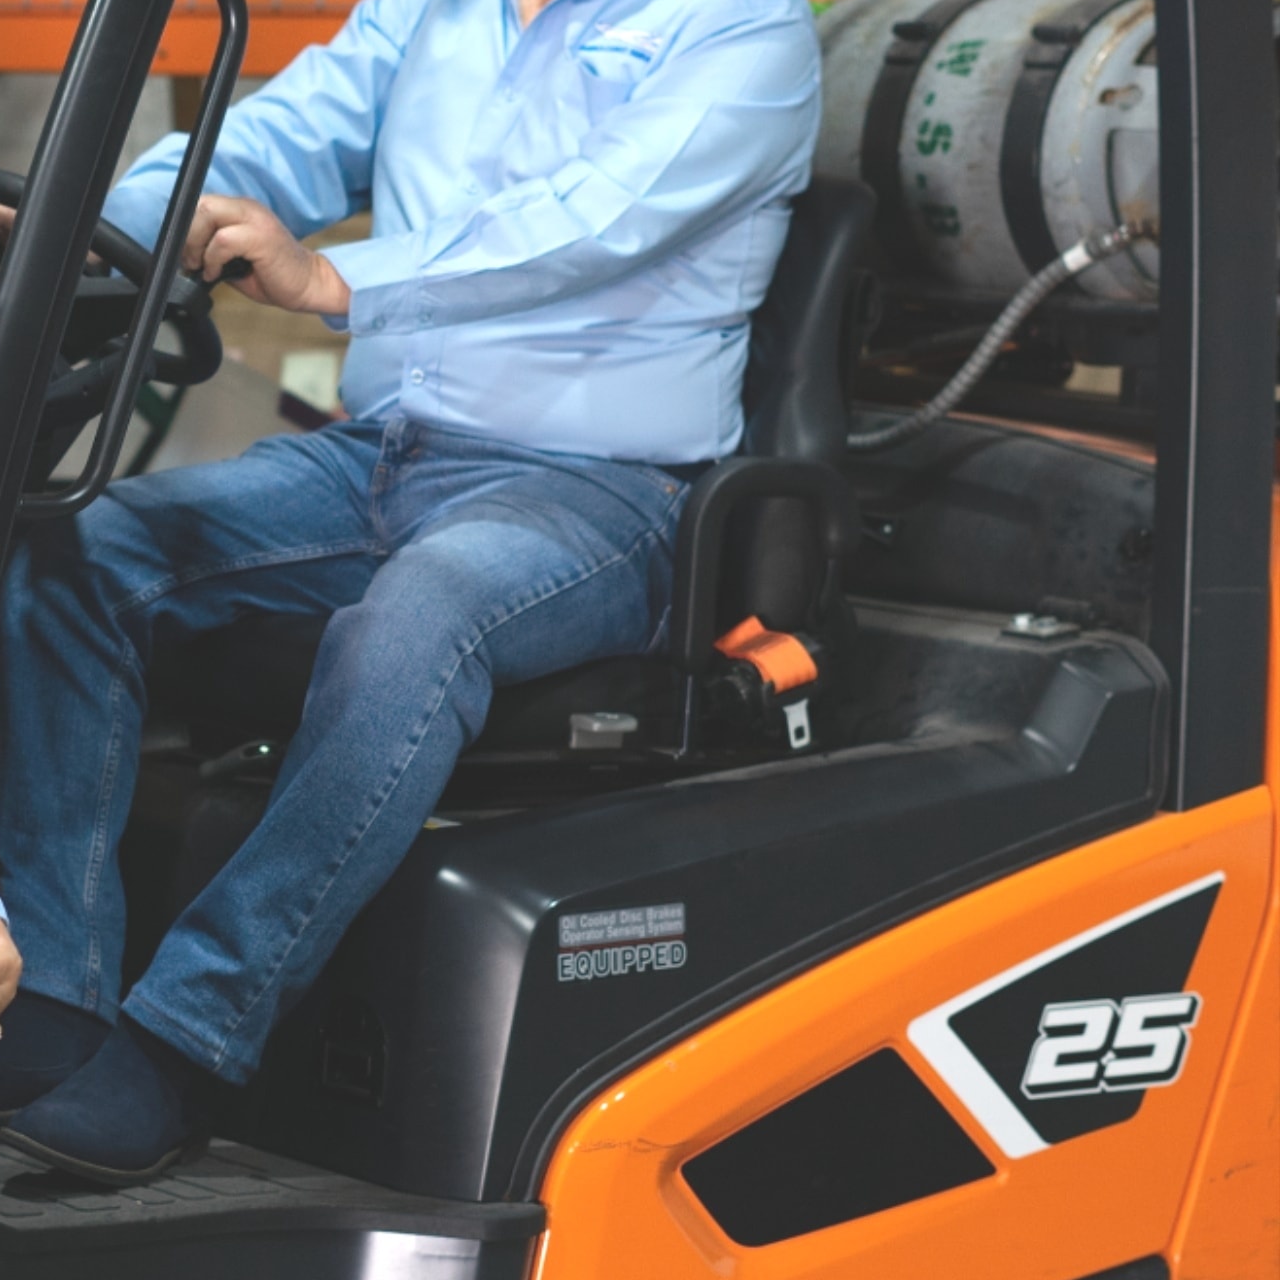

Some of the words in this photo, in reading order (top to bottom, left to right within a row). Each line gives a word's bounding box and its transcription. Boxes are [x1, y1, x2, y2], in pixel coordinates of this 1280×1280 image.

[562, 915, 577, 929] Oil
[580, 912, 617, 928] Cooled
[620, 910, 642, 923] Disc
[646, 905, 683, 920] Brakes
[562, 928, 605, 944] Operator
[607, 924, 646, 939] Sensing
[647, 920, 683, 935] System
[558, 940, 687, 981] EQUIPPED
[1022, 993, 1201, 1097] 25
